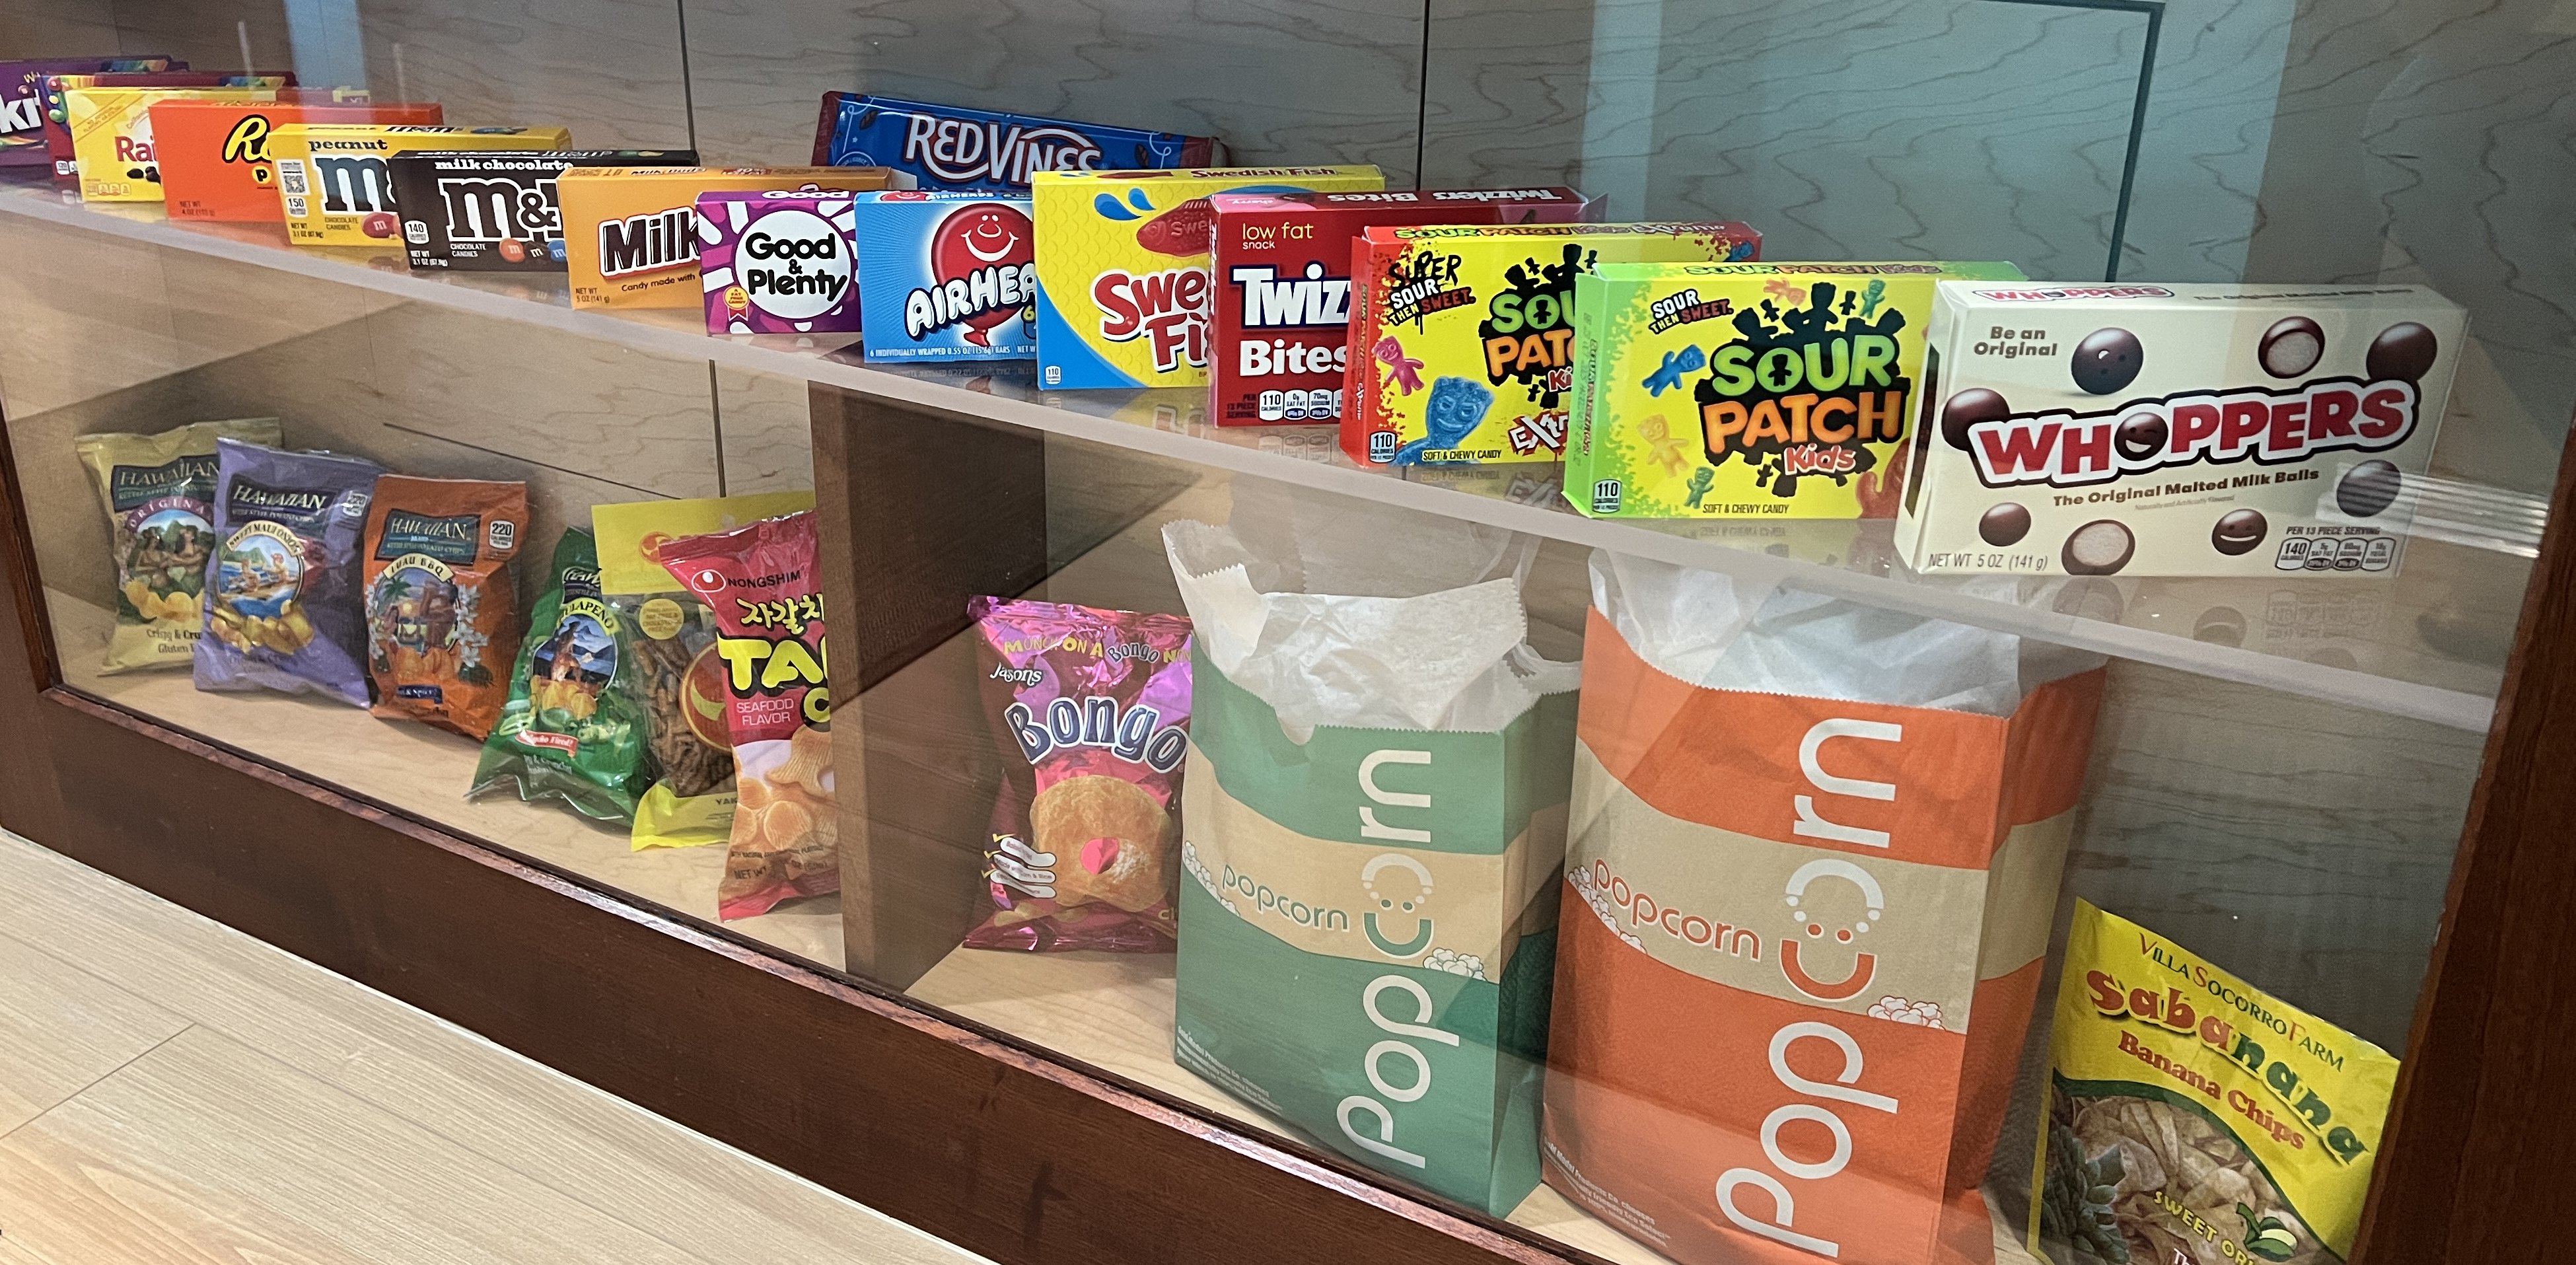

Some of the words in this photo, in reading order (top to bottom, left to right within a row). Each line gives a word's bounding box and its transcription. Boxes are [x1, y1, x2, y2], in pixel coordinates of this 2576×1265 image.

[308, 139, 388, 152] peanut
[434, 158, 482, 170] milk
[482, 159, 573, 170] chocolate
[1190, 168, 1283, 178] Swedish
[1287, 167, 1336, 176] Fish
[289, 198, 304, 207] 150
[762, 190, 850, 199] Good
[408, 223, 424, 233] 140
[1242, 223, 1277, 240] low
[1281, 221, 1314, 239] fat
[1396, 227, 1480, 238] SOUR
[1479, 227, 1571, 236] PATCH
[602, 210, 701, 273] Milk
[746, 233, 836, 260] Good
[1242, 240, 1275, 250] snack
[789, 259, 803, 275] &
[1685, 266, 1779, 275] SOUR
[1778, 265, 1878, 274] PATCH
[622, 281, 649, 292] Candy
[651, 277, 675, 287] made
[677, 273, 696, 282] with
[747, 269, 848, 301] Plenty
[1390, 278, 1439, 309] SOUR
[1977, 286, 2169, 301] WHOPPERS
[1389, 303, 1419, 324] THEN
[1653, 289, 1700, 319] SOUR
[1650, 313, 1680, 334] THEN
[1990, 326, 2015, 340] Be
[2021, 329, 2046, 340] an
[1145, 312, 1209, 367] Fi
[917, 347, 947, 356] WRAPPED
[1239, 338, 1347, 377] Bites
[1974, 342, 2058, 359] Original
[1712, 334, 1896, 393] SOUR
[1262, 394, 1281, 406] 110
[1703, 390, 1902, 454] PATCH
[1374, 434, 1392, 448] 110
[1977, 388, 2406, 476] WHOPPERS
[1423, 452, 1440, 460] SOFT
[1449, 451, 1476, 460] CHEWY
[1477, 450, 1502, 458] CANDY
[1785, 443, 1857, 476] Kids
[1597, 482, 1618, 497] 110
[2054, 494, 2084, 507] The
[2088, 485, 2161, 504] Original
[2165, 477, 2228, 495] Malted
[2232, 473, 2271, 488] Milk
[2275, 468, 2320, 484] Balls
[1703, 503, 1723, 515] SOFT
[1725, 503, 1731, 515] &
[1731, 503, 1760, 515] CHEWY
[1762, 503, 1789, 515] CANDY
[491, 523, 513, 536] 220
[2286, 526, 2304, 535] PER
[2317, 526, 2343, 535] PIECE
[2285, 542, 2308, 555] 140
[420, 557, 445, 578] BBQ
[1928, 553, 1951, 567] NET
[1953, 553, 1973, 567] WT
[1977, 553, 1985, 567] 5
[1988, 553, 2004, 567] OZ
[2009, 553, 2032, 569] (141
[727, 569, 801, 589] NONGSHIM
[174, 629, 181, 639] &
[158, 643, 189, 653] Gluten
[1062, 637, 1087, 653] ON
[1090, 643, 1104, 658] A
[1108, 642, 1160, 663] Bongo
[717, 637, 828, 690] TA
[989, 662, 1042, 686] Jasons
[736, 698, 794, 714] SEAFOOD
[742, 713, 791, 726] FLAVOR
[1003, 696, 1190, 774] Bongo
[734, 869, 752, 880] NET
[1221, 864, 1349, 931] popcorn
[1591, 857, 1763, 962] popcorn
[1336, 749, 1460, 1169] popcorn
[1716, 717, 1902, 1258] popcorn
[2139, 933, 2190, 980] VILLA
[2192, 965, 2288, 1036] SOCORRO
[2287, 1019, 2345, 1073] FARM
[2118, 1030, 2222, 1101] Banana
[2227, 1089, 2306, 1151] Chips
[2153, 1190, 2219, 1243] SWEET
